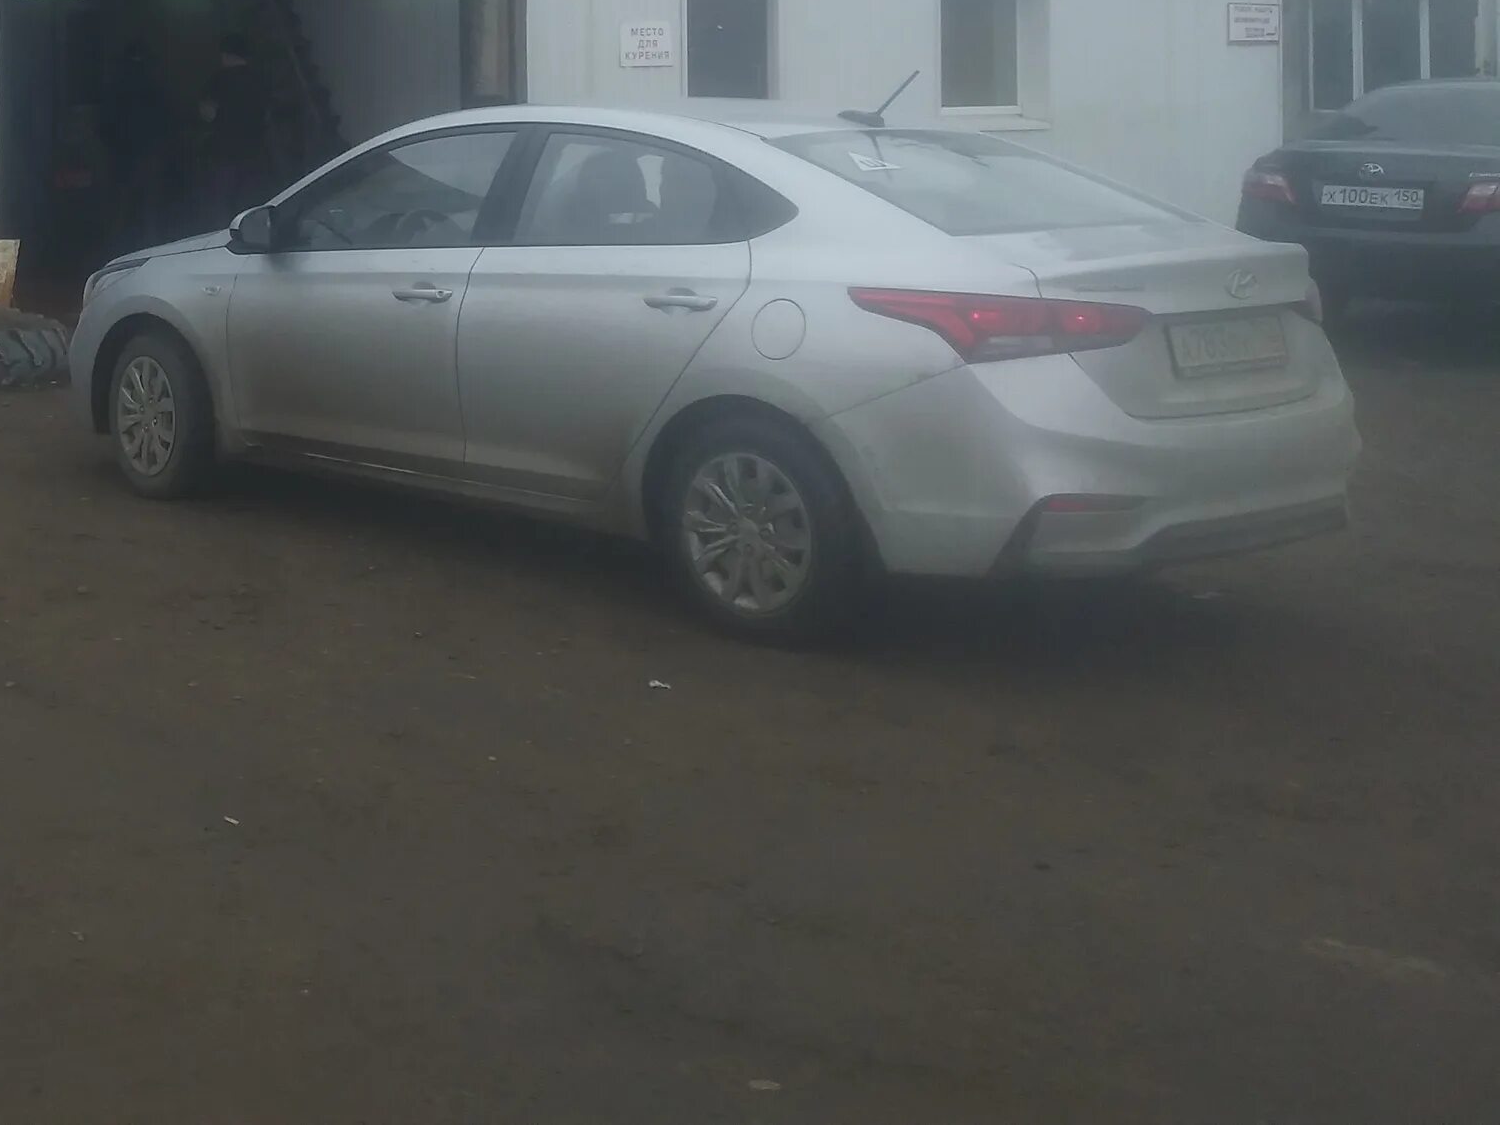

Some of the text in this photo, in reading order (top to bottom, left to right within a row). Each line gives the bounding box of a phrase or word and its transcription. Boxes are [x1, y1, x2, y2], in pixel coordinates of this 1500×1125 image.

[630, 27, 664, 37] МЕСТО
[638, 39, 659, 50] ДЛЯ
[625, 50, 670, 60] КУРЕНИЯ
[1394, 189, 1419, 203] 150
